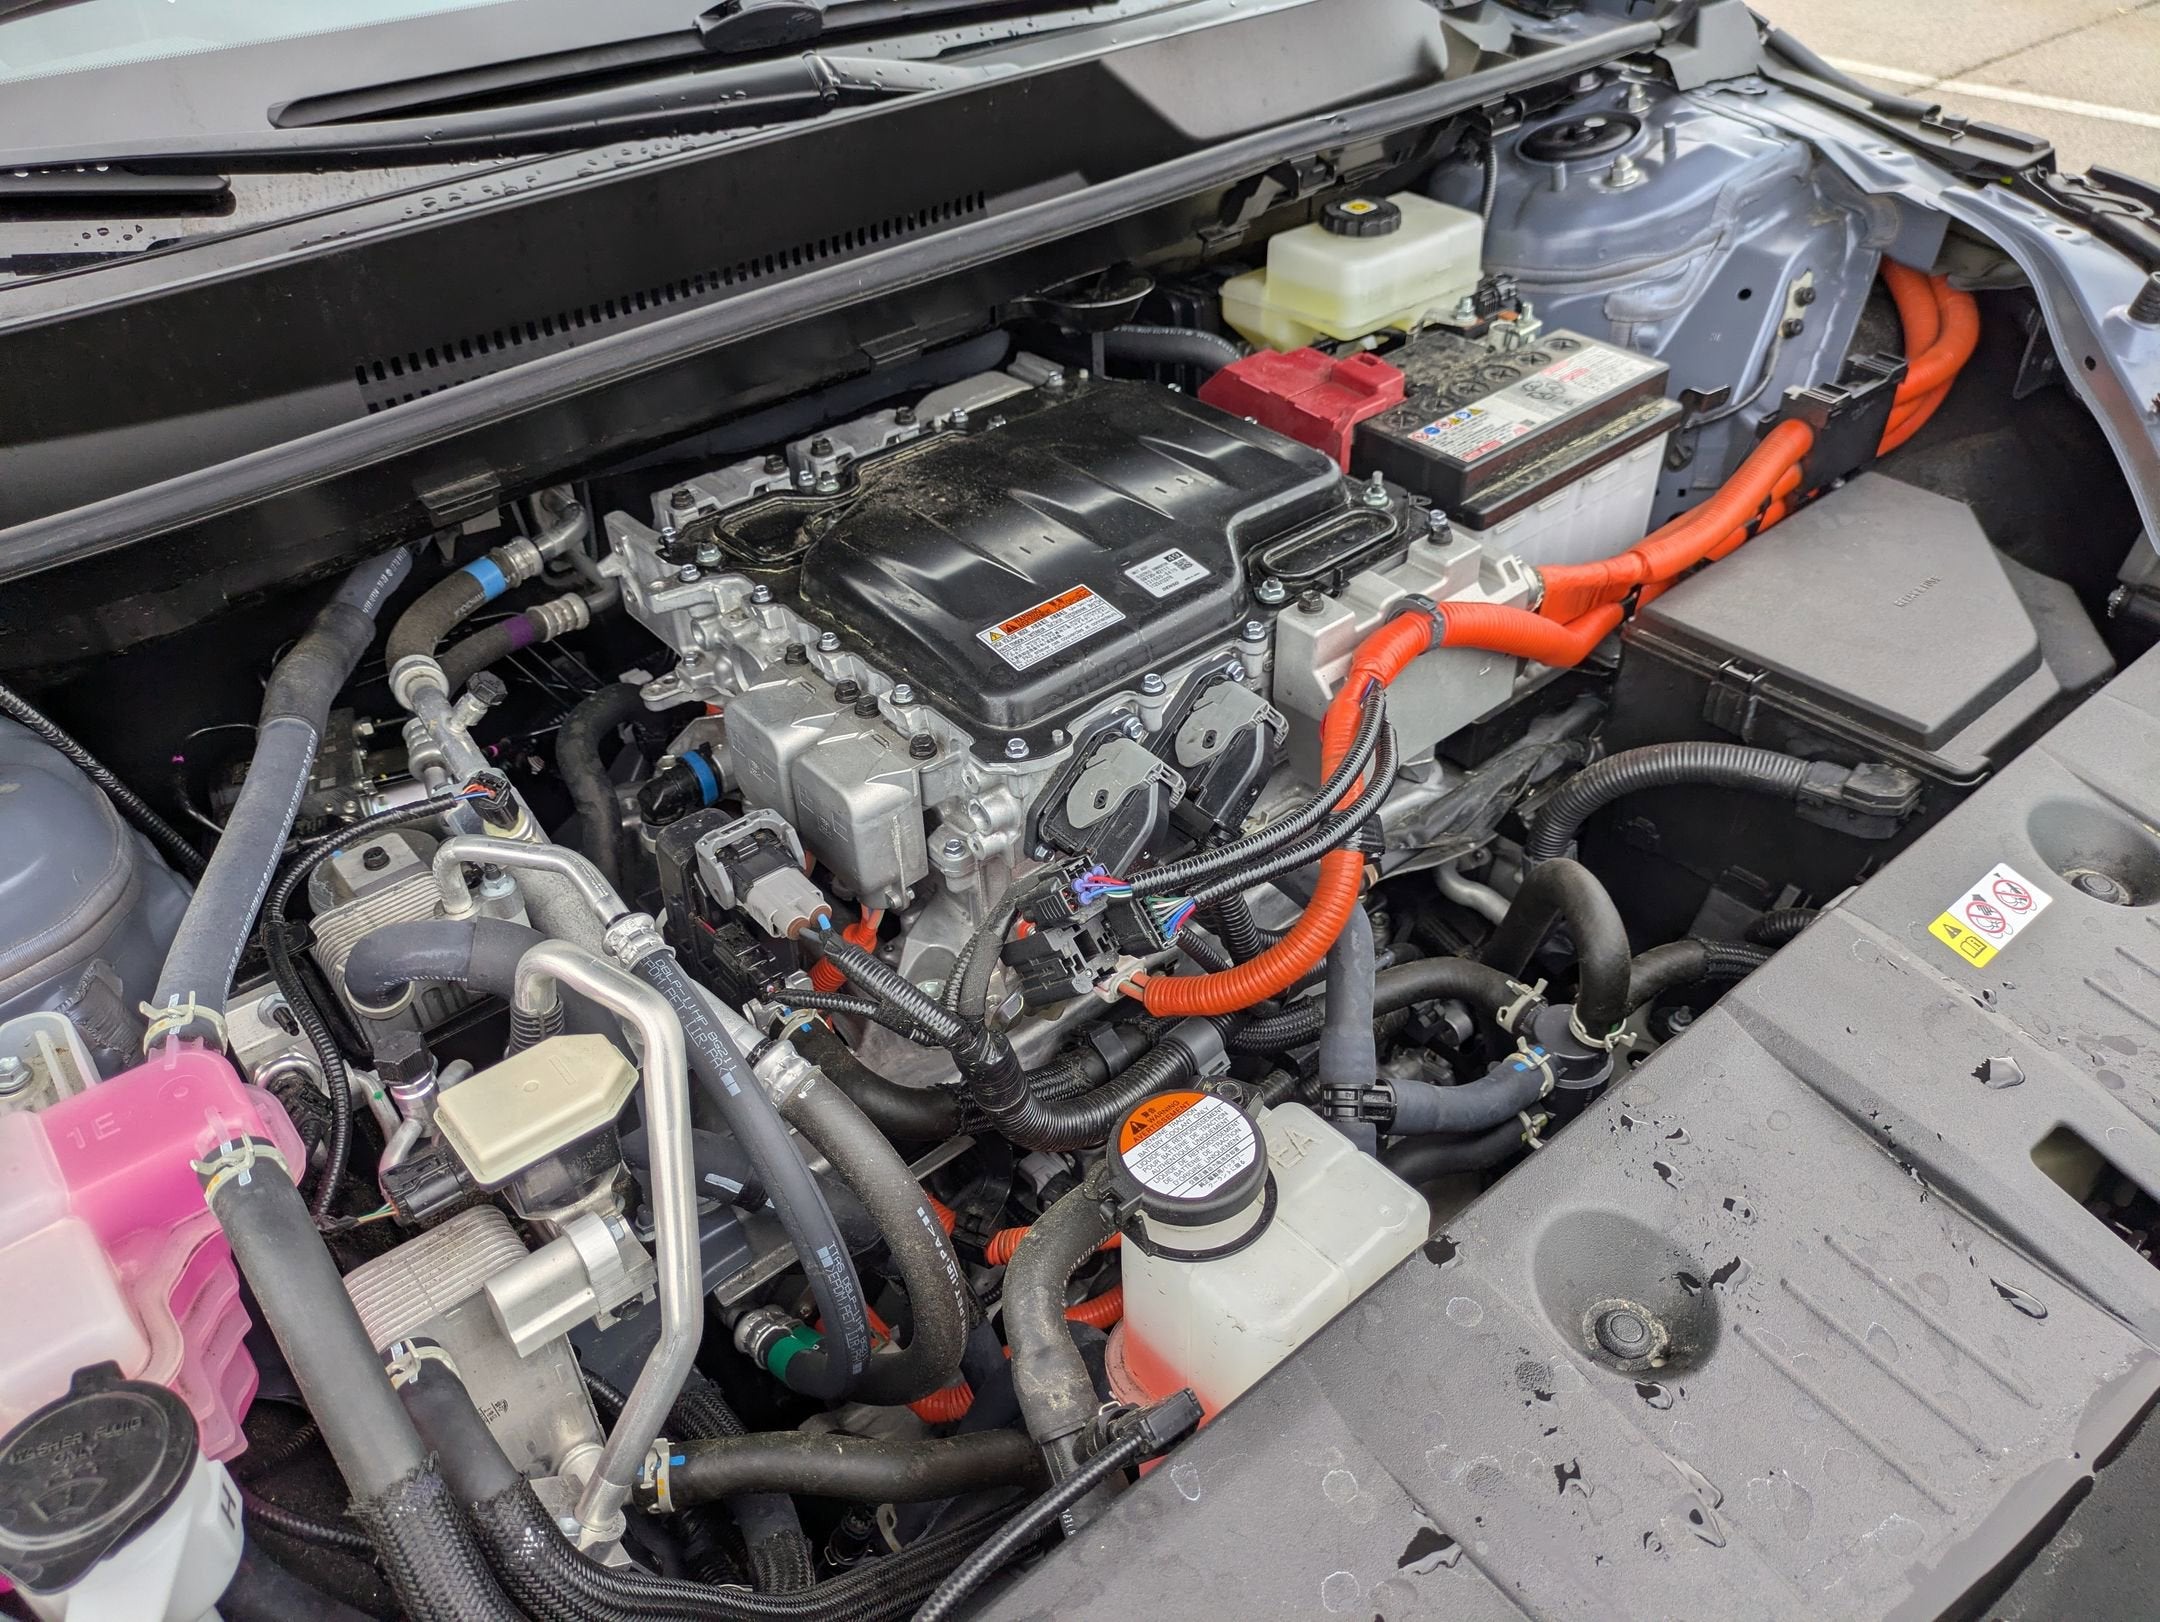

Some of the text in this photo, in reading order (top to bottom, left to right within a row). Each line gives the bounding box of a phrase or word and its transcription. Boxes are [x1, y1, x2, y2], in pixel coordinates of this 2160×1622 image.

[1134, 1100, 1190, 1143] AVERTISSEMENT
[1138, 1105, 1207, 1157] BATTERY COOLANT ONLY
[1141, 1107, 1196, 1147] GENUINE TRACTION
[1147, 1099, 1179, 1122] WARNING
[1136, 1106, 1223, 1169] LIQUIDE DE REFROIDISSEMENT
[1142, 1110, 1228, 1173] POUR BATTERIE DE TRACTION
[1151, 1117, 1229, 1175] AUTHENTIQUE UNIQUEMENT
[1153, 1120, 1240, 1183] LIQUIDE DE REFROIDISSEMENT
[1163, 1127, 1241, 1184] DE BATTERIE DE TRACTION
[1173, 1135, 1241, 1185] D'ORIGINE UNIQUEMENT
[9, 1415, 142, 1464] WASHER FLUID
[53, 1442, 99, 1465] ONLY
[221, 1482, 236, 1530] H
